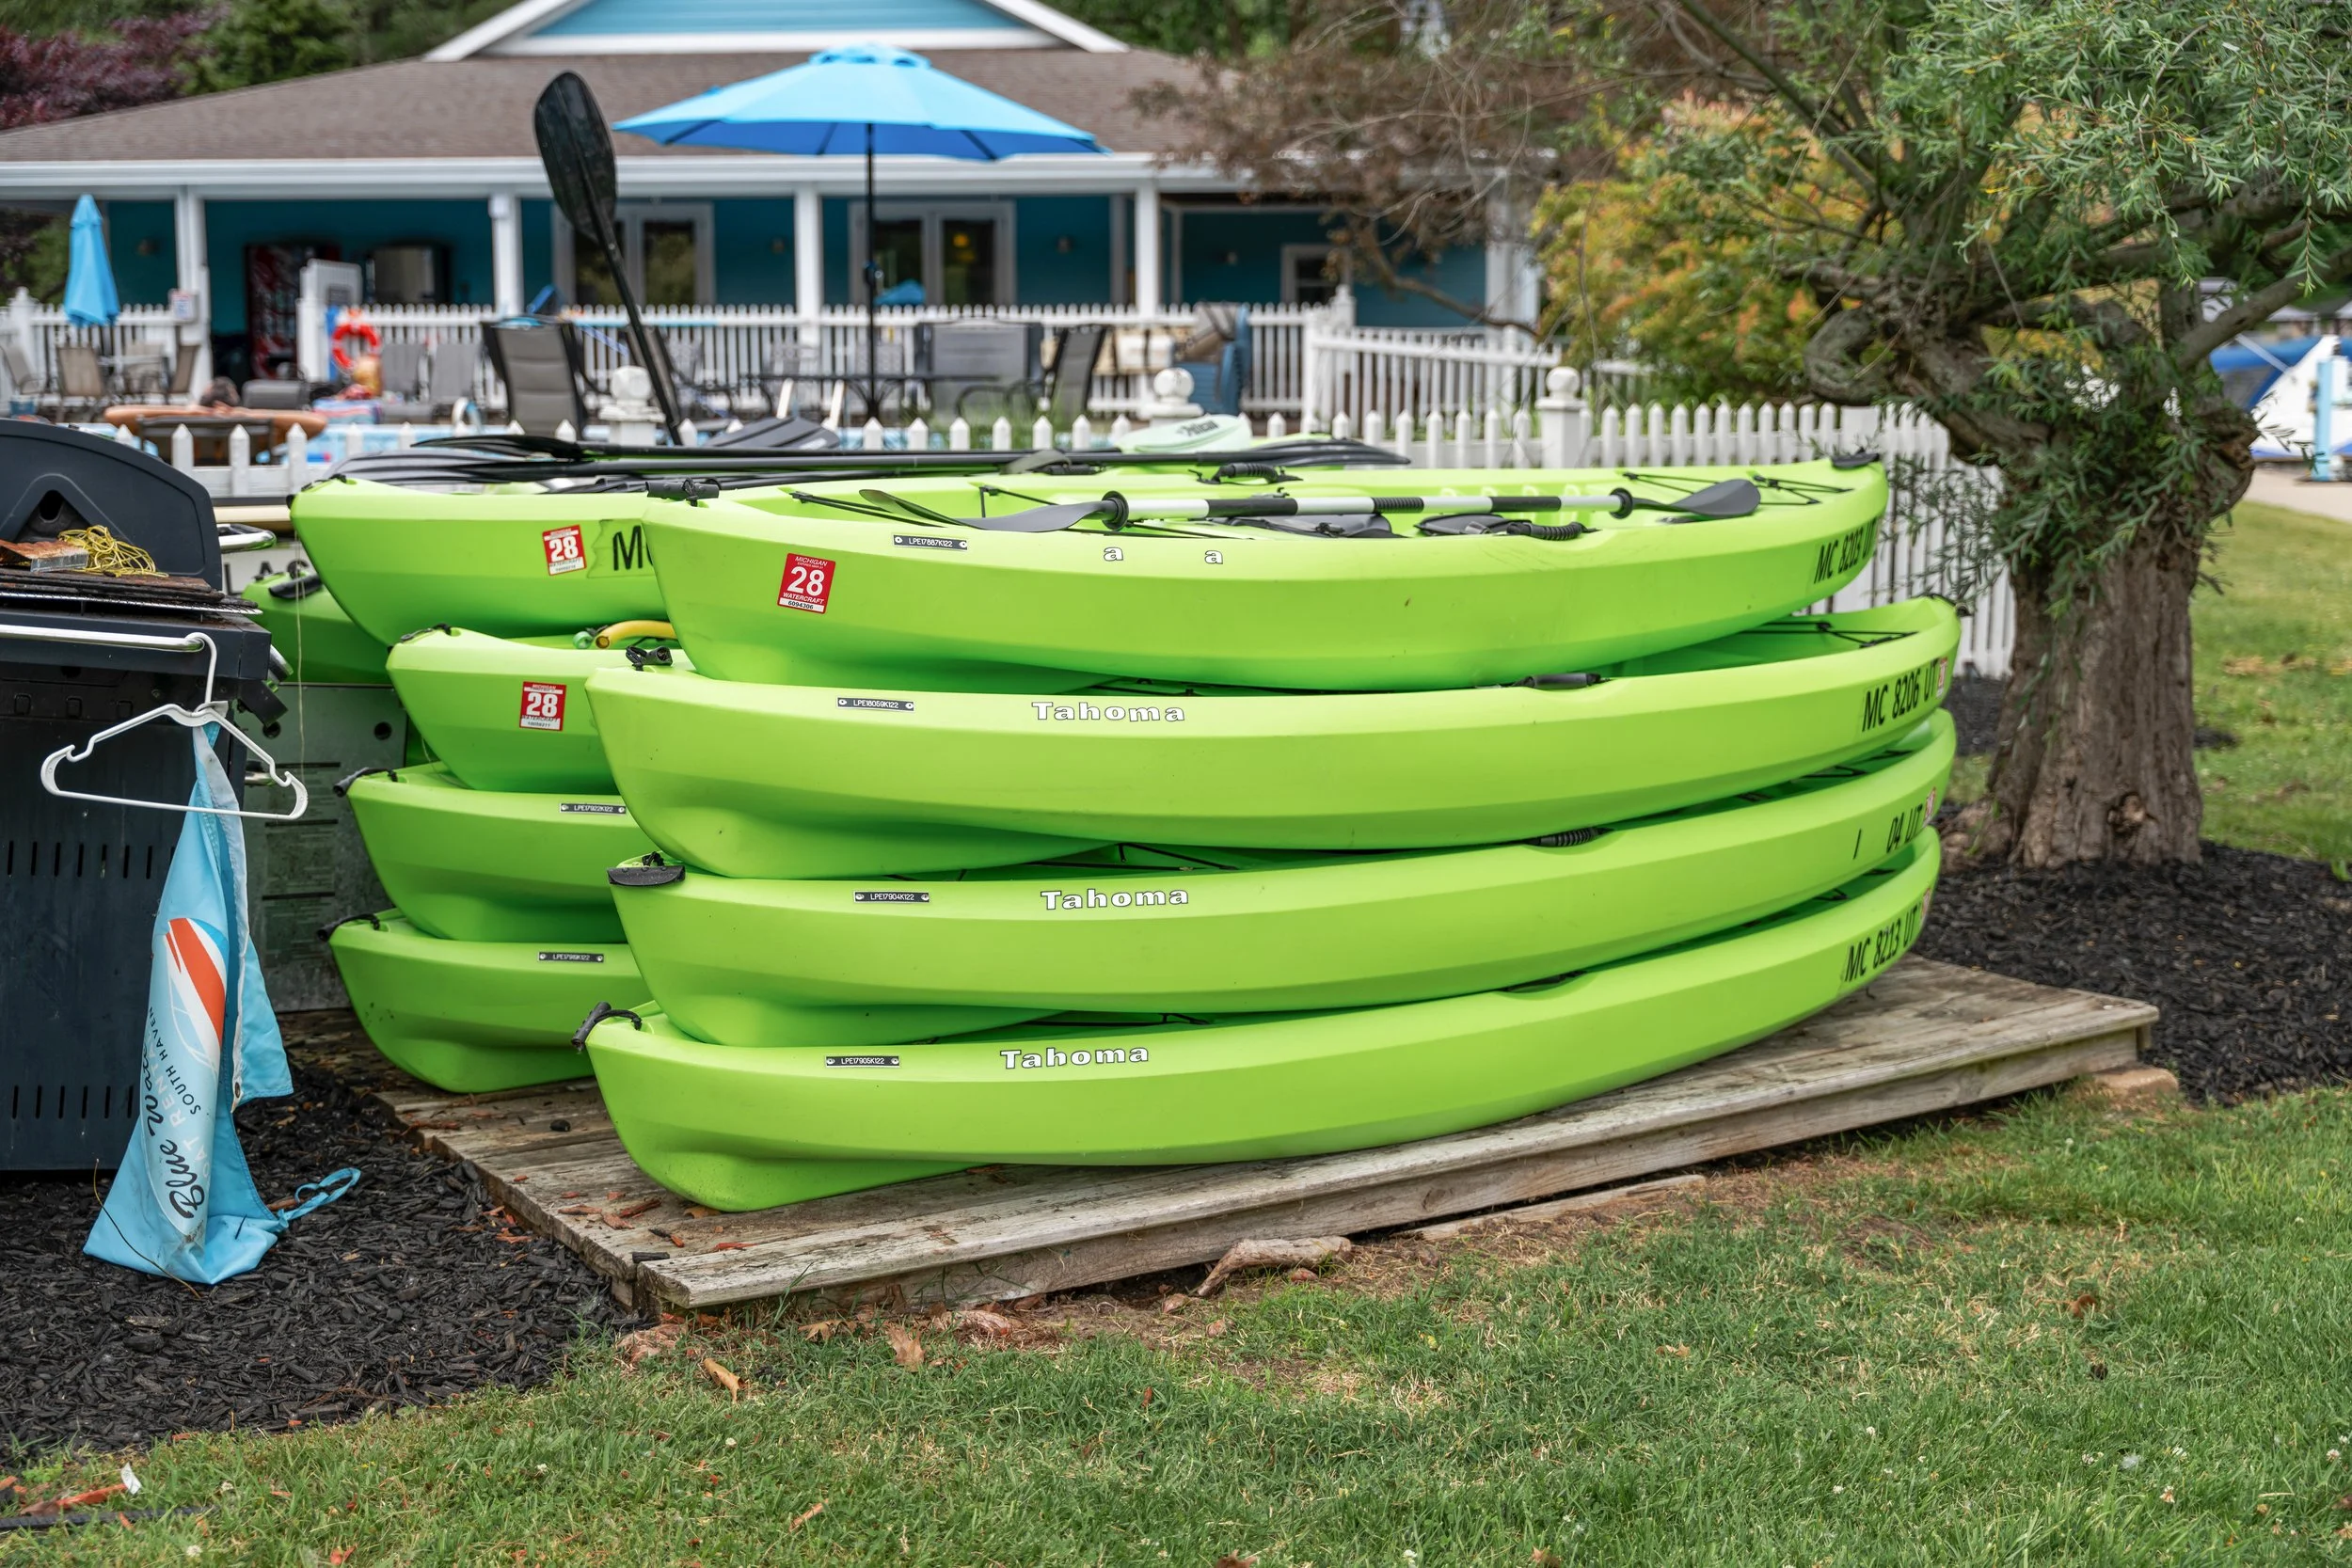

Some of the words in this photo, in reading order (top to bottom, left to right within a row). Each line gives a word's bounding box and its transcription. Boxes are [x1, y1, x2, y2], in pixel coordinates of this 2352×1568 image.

[549, 536, 579, 562] 28
[612, 525, 653, 571] M
[795, 556, 828, 566] MICHIGAN
[1104, 546, 1123, 562] a
[1204, 550, 1223, 564] a
[1814, 539, 1838, 584] MC
[787, 566, 824, 596] 28
[783, 593, 824, 605] WATERCRAFT
[787, 600, 814, 610] 6094306
[526, 692, 558, 717] 28
[1862, 684, 1888, 732] MC
[1892, 668, 1920, 720] 8206
[1924, 657, 1939, 702] UT
[1031, 702, 1184, 721] Tahoma
[1904, 803, 1923, 844] UT
[1041, 888, 1188, 910] Tahoma
[1845, 937, 1870, 982] MC
[1873, 918, 1901, 969] 8213
[1903, 904, 1917, 947] UT
[1000, 1047, 1149, 1069] Tahoma
[166, 1065, 201, 1115] SOUTH
[183, 1136, 210, 1178] OAT
[160, 1139, 204, 1218] Blue
